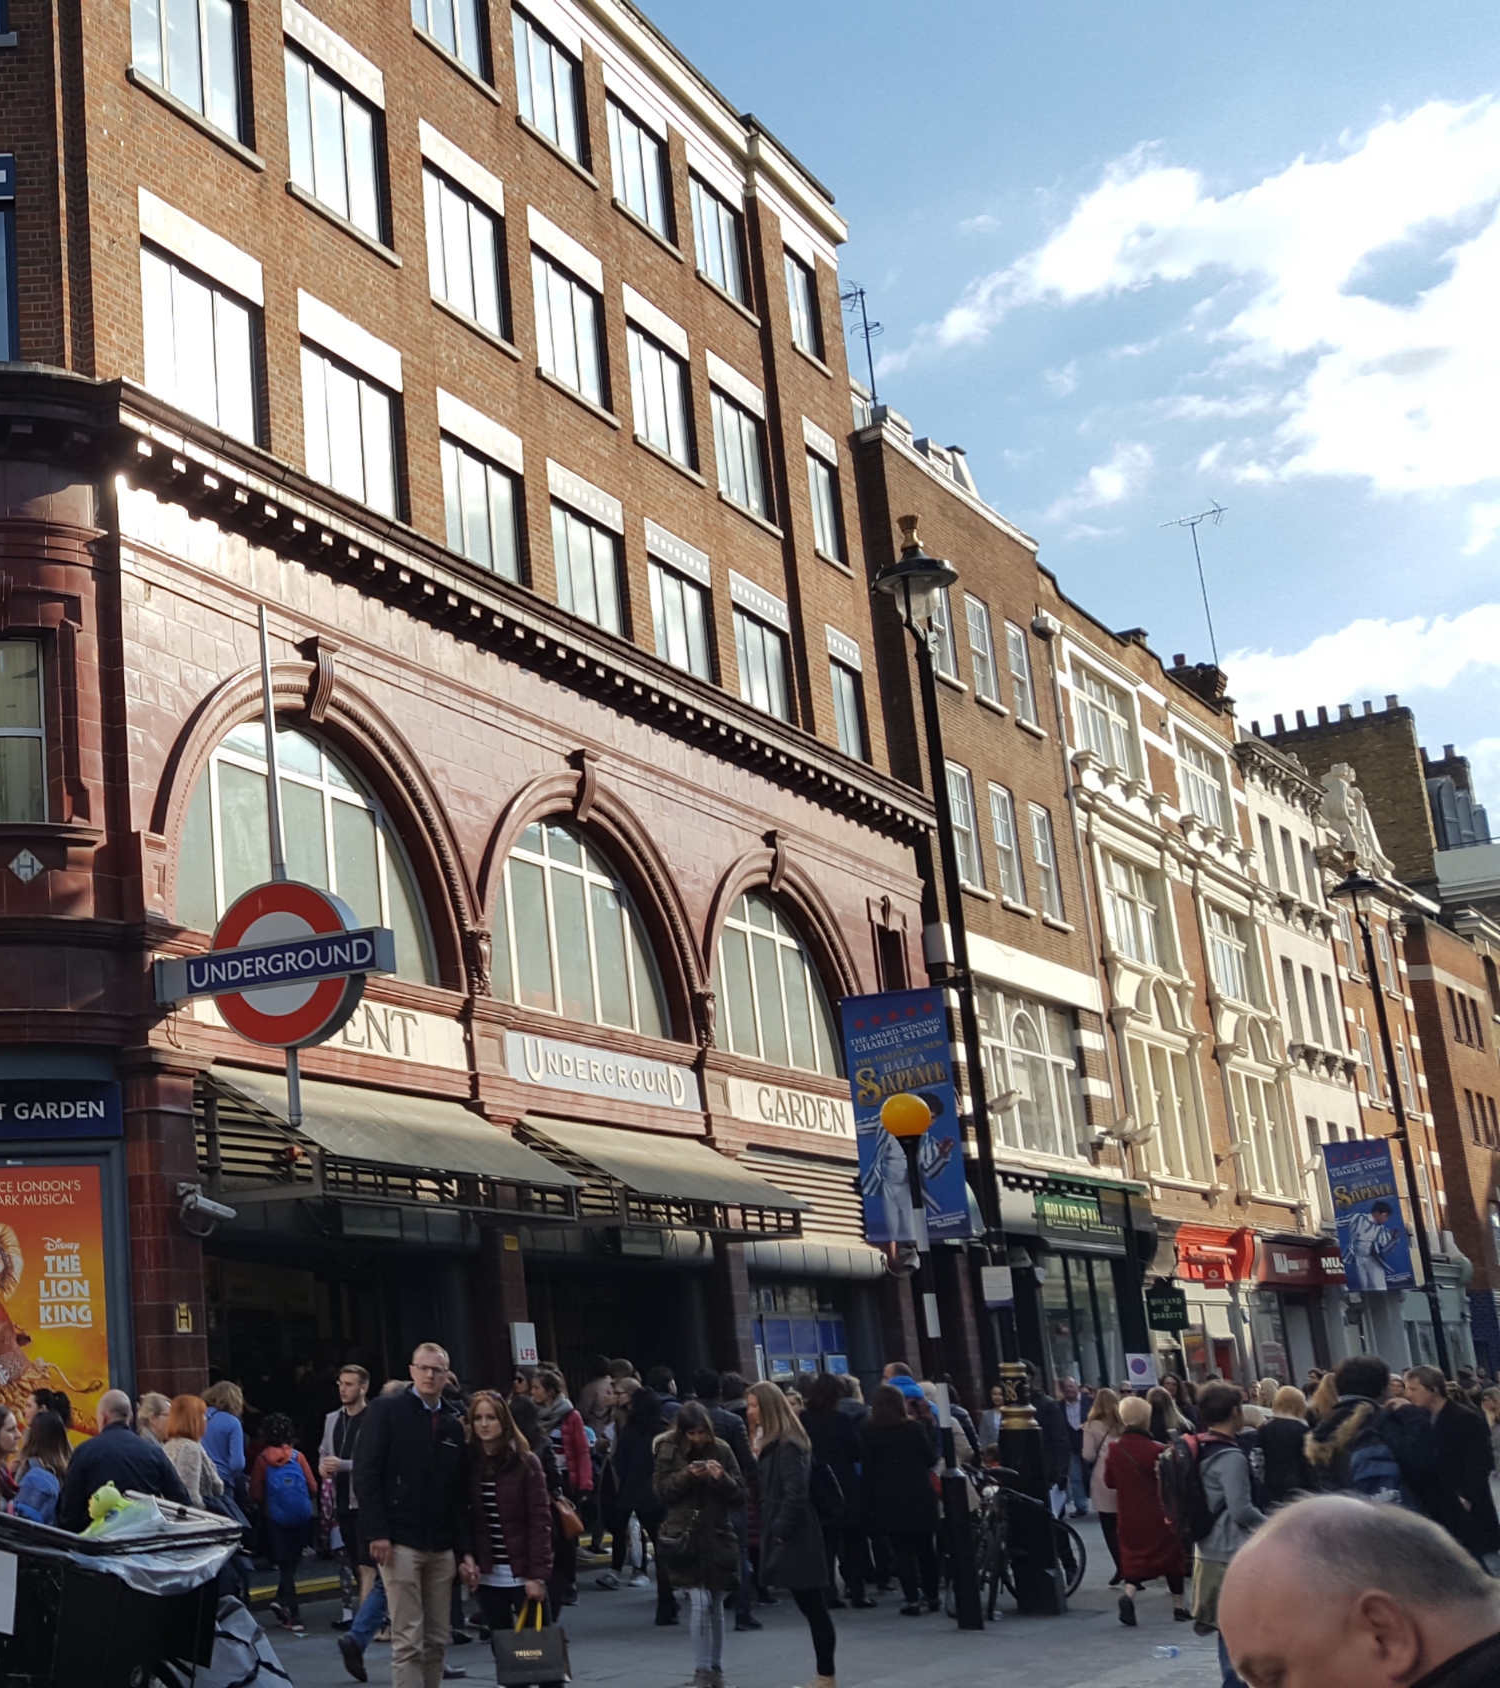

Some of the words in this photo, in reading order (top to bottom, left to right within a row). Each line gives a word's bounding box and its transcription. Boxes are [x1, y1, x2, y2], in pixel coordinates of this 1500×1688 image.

[16, 857, 34, 876] H
[190, 938, 374, 988] UNDERGROUND
[854, 1035, 902, 1053] CHARLIE
[903, 1025, 940, 1041] STEMP
[523, 1036, 686, 1106] UNDERGROUND
[883, 1056, 915, 1074] HALF
[917, 1053, 927, 1064] A
[855, 1060, 947, 1107] SIXPENCE
[13, 1100, 105, 1121] GARDEN
[757, 1085, 847, 1136] GARDEN
[16, 1180, 81, 1193] LONDON'S
[22, 1193, 75, 1206] MUSICAL
[43, 1254, 81, 1273] THE
[39, 1280, 90, 1298] LION
[39, 1304, 93, 1323] KING
[520, 1348, 536, 1361] LFB
